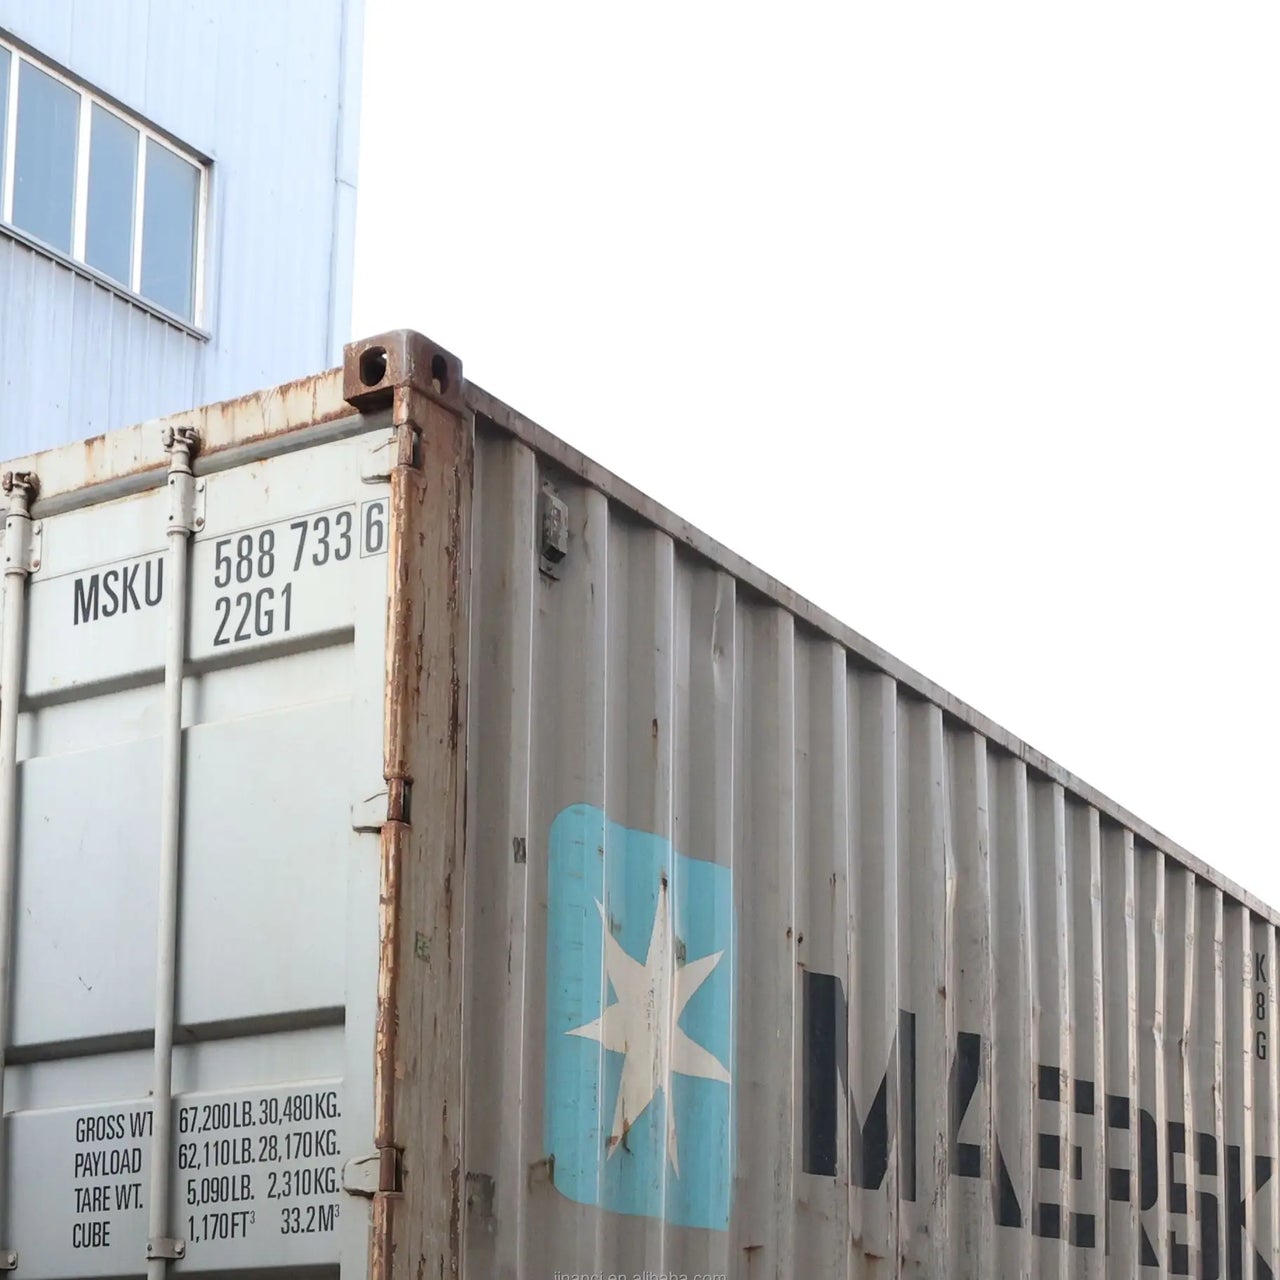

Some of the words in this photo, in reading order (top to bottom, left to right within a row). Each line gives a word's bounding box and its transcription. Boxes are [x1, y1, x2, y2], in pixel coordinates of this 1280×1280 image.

[73, 557, 164, 626] MSKU
[214, 529, 275, 588] 588
[290, 511, 353, 572] 733
[213, 581, 292, 647] 22G1
[75, 1113, 125, 1143] GROSS
[74, 1147, 142, 1178] PAYLOAD
[74, 1185, 111, 1214] TARE
[115, 1182, 144, 1211] WT.
[72, 1220, 111, 1249] CUBE
